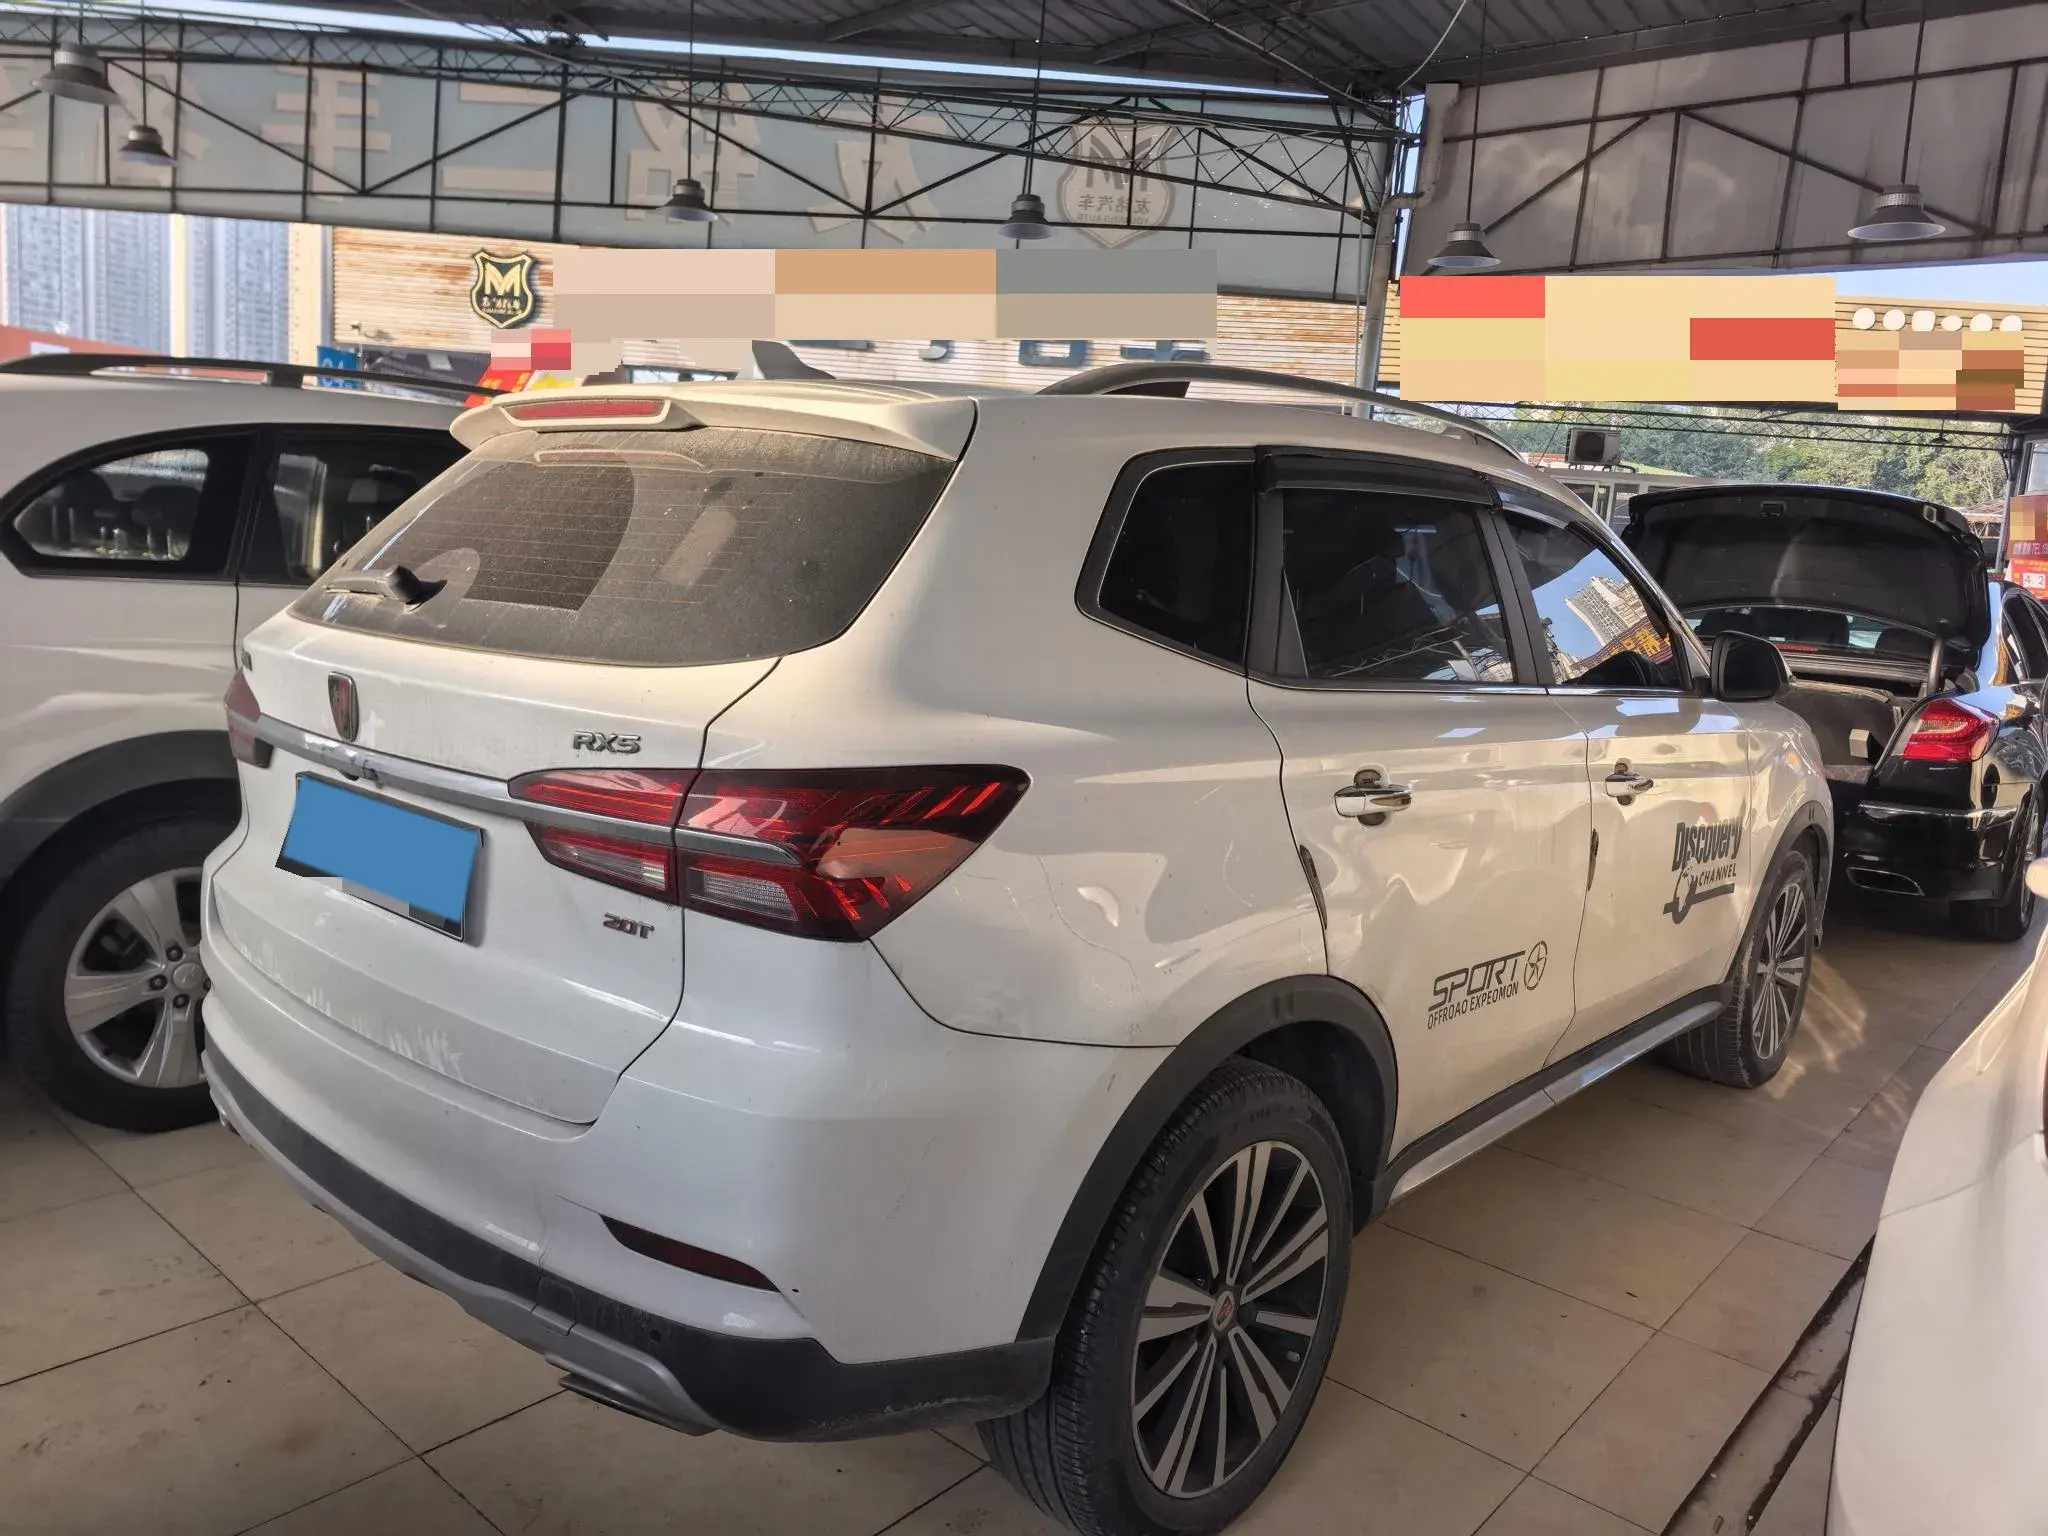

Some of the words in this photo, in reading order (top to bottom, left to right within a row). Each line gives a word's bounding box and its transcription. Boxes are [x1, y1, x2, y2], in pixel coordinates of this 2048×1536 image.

[573, 730, 641, 753] RX5
[1698, 862, 1737, 887] CHANNEL
[603, 912, 655, 940] 20T
[1428, 950, 1526, 1012] SPORT
